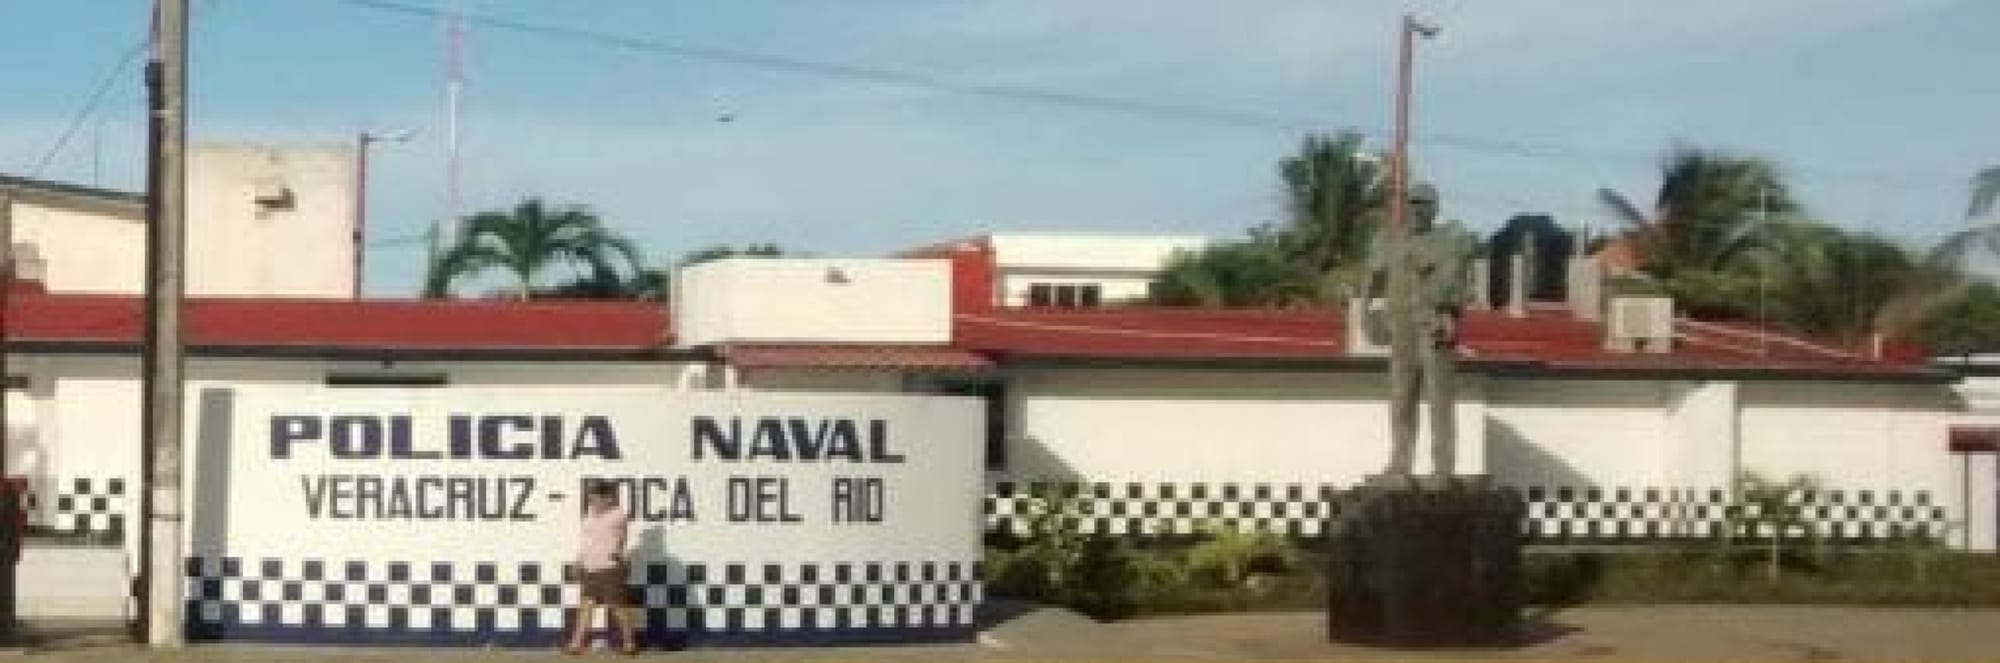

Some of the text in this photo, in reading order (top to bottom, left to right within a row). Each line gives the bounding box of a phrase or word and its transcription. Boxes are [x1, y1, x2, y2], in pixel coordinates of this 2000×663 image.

[270, 414, 906, 463] POLICIA NAVAL
[302, 475, 537, 522] VERACRUZ
[728, 475, 803, 523] DEL
[832, 476, 884, 524] RIO
